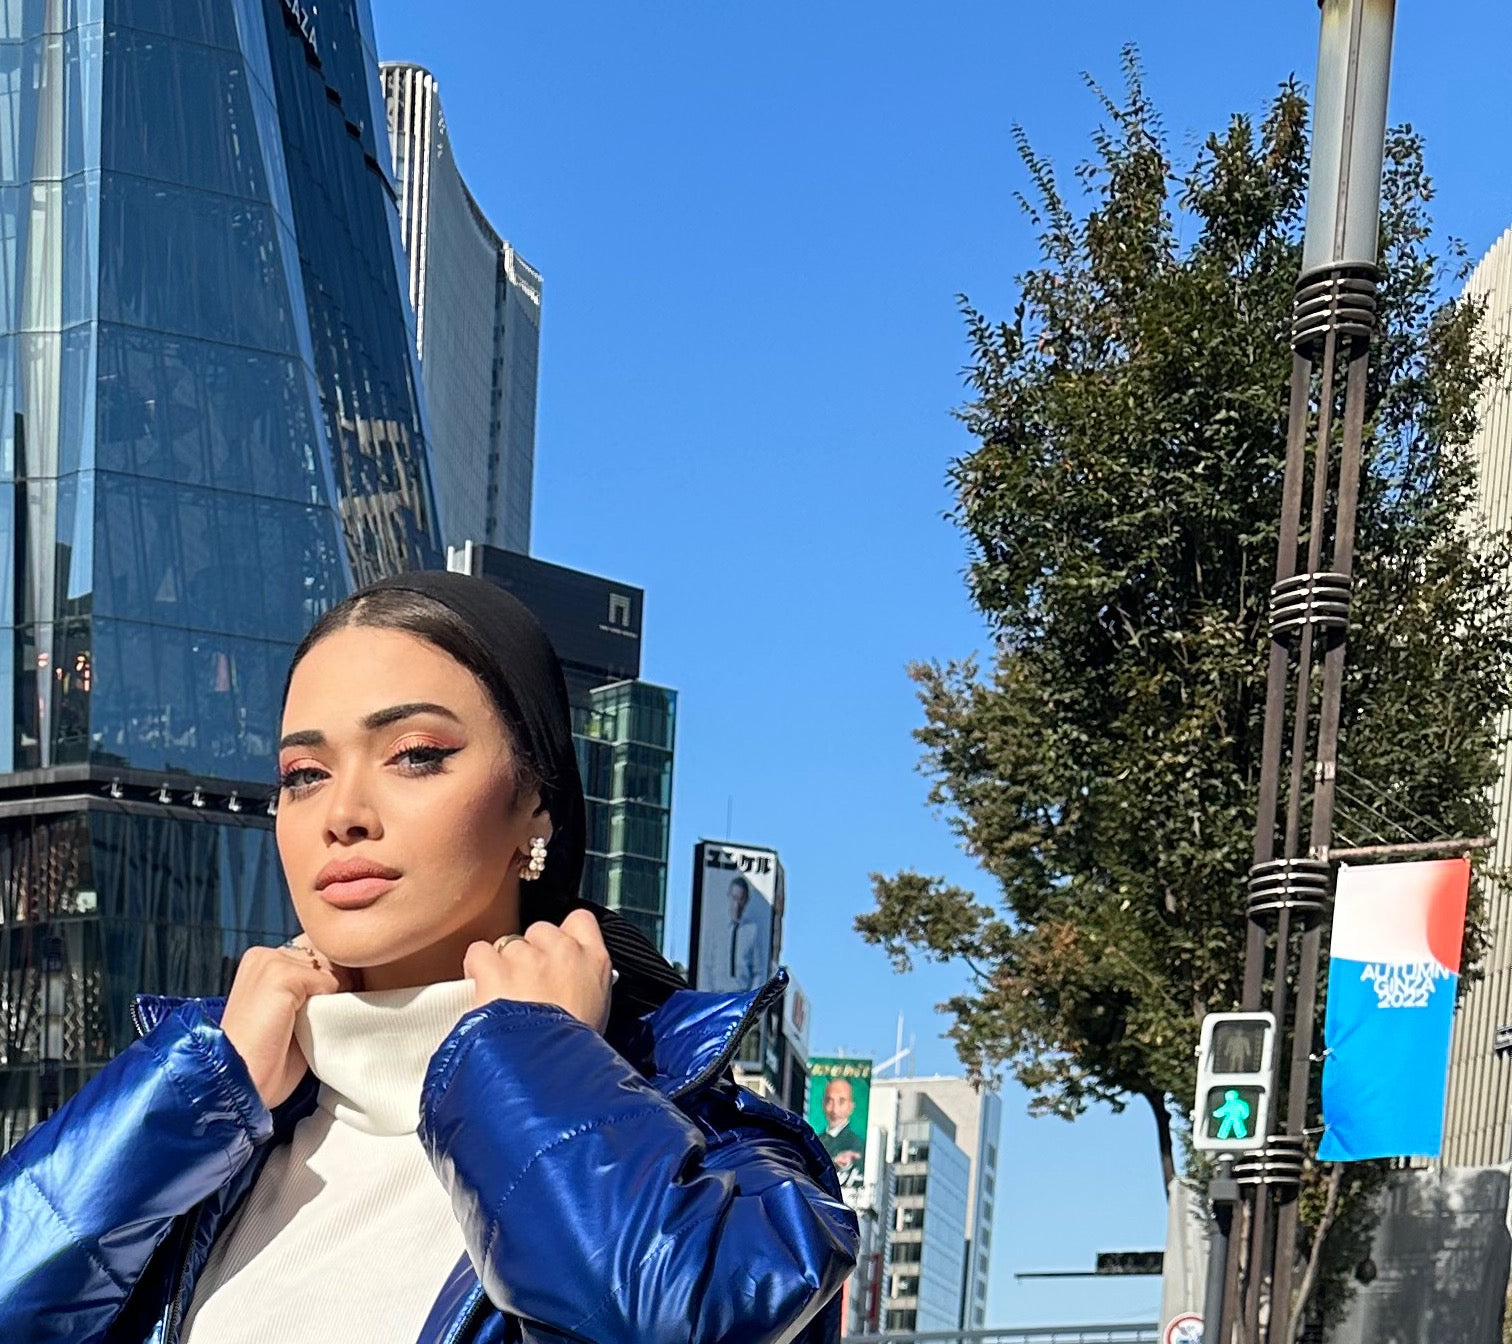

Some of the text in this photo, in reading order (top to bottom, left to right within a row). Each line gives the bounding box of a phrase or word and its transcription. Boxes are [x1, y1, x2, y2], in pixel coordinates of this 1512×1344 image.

[1360, 962, 1450, 982] AUTUMN
[1373, 977, 1437, 994] GINZA
[1377, 991, 1429, 1008] 2022
